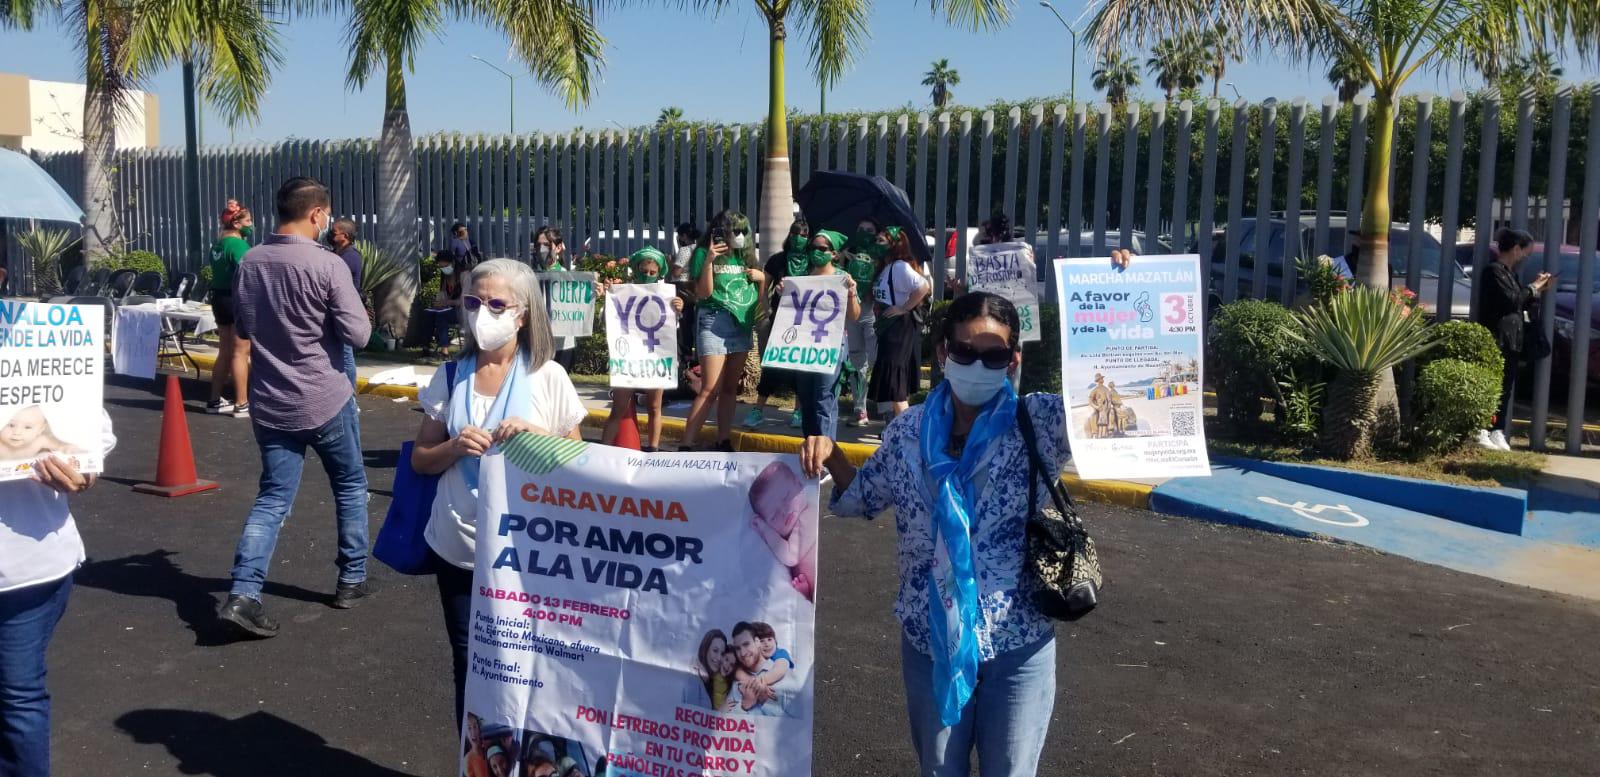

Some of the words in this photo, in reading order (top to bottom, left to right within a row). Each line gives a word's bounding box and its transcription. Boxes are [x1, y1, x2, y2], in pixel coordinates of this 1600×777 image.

[1069, 272, 1122, 285] MARCHA
[1070, 292, 1082, 302] A
[1085, 290, 1130, 302] favor
[1079, 302, 1093, 310] de
[1095, 302, 1106, 310] la
[0, 301, 84, 326] NALOA
[1074, 307, 1137, 325] mujer
[1164, 294, 1186, 324] 3
[38, 329, 56, 347] LA
[60, 329, 93, 347] VIDA
[1072, 327, 1078, 335] y
[1080, 325, 1095, 333] de
[1096, 325, 1107, 333] la
[1109, 325, 1154, 340] vida
[0, 359, 22, 378] DA
[27, 357, 94, 376] MERECE
[0, 384, 64, 405] ESPETO
[627, 457, 642, 467] VIA
[644, 458, 680, 468] FAMILIA
[682, 459, 738, 471] MAZATLAN
[520, 483, 688, 522] CARAVANA
[498, 513, 580, 547] POR
[584, 526, 704, 564] AMOR
[492, 546, 522, 573] A
[527, 549, 574, 580] LA
[581, 557, 668, 595] VIDA
[479, 586, 541, 604] SABADO
[543, 596, 560, 608] 13
[562, 599, 631, 620] FEBRERO
[475, 610, 494, 623] Punto
[496, 615, 530, 629] Inicial:
[522, 607, 557, 622] 4:00
[559, 613, 583, 627] PM
[474, 622, 485, 633] Av.
[486, 624, 519, 639] Ejército
[522, 630, 568, 648] Mexicano,
[570, 639, 600, 654] afuera
[474, 634, 543, 653] estacionamiento
[545, 645, 585, 662] Walmart
[473, 652, 492, 668] Punto
[493, 658, 521, 673] Final:
[480, 665, 544, 688] Ayuntamiento
[576, 705, 607, 725] PON
[610, 712, 679, 741] LETREROS
[683, 729, 756, 754] PROVIDA
[675, 706, 755, 734] RECUERDA:
[607, 752, 684, 777] PAÑOLETAS
[645, 741, 664, 758] EN
[666, 745, 683, 763] TU
[686, 751, 739, 773] CARRO
[744, 759, 756, 774] Y
